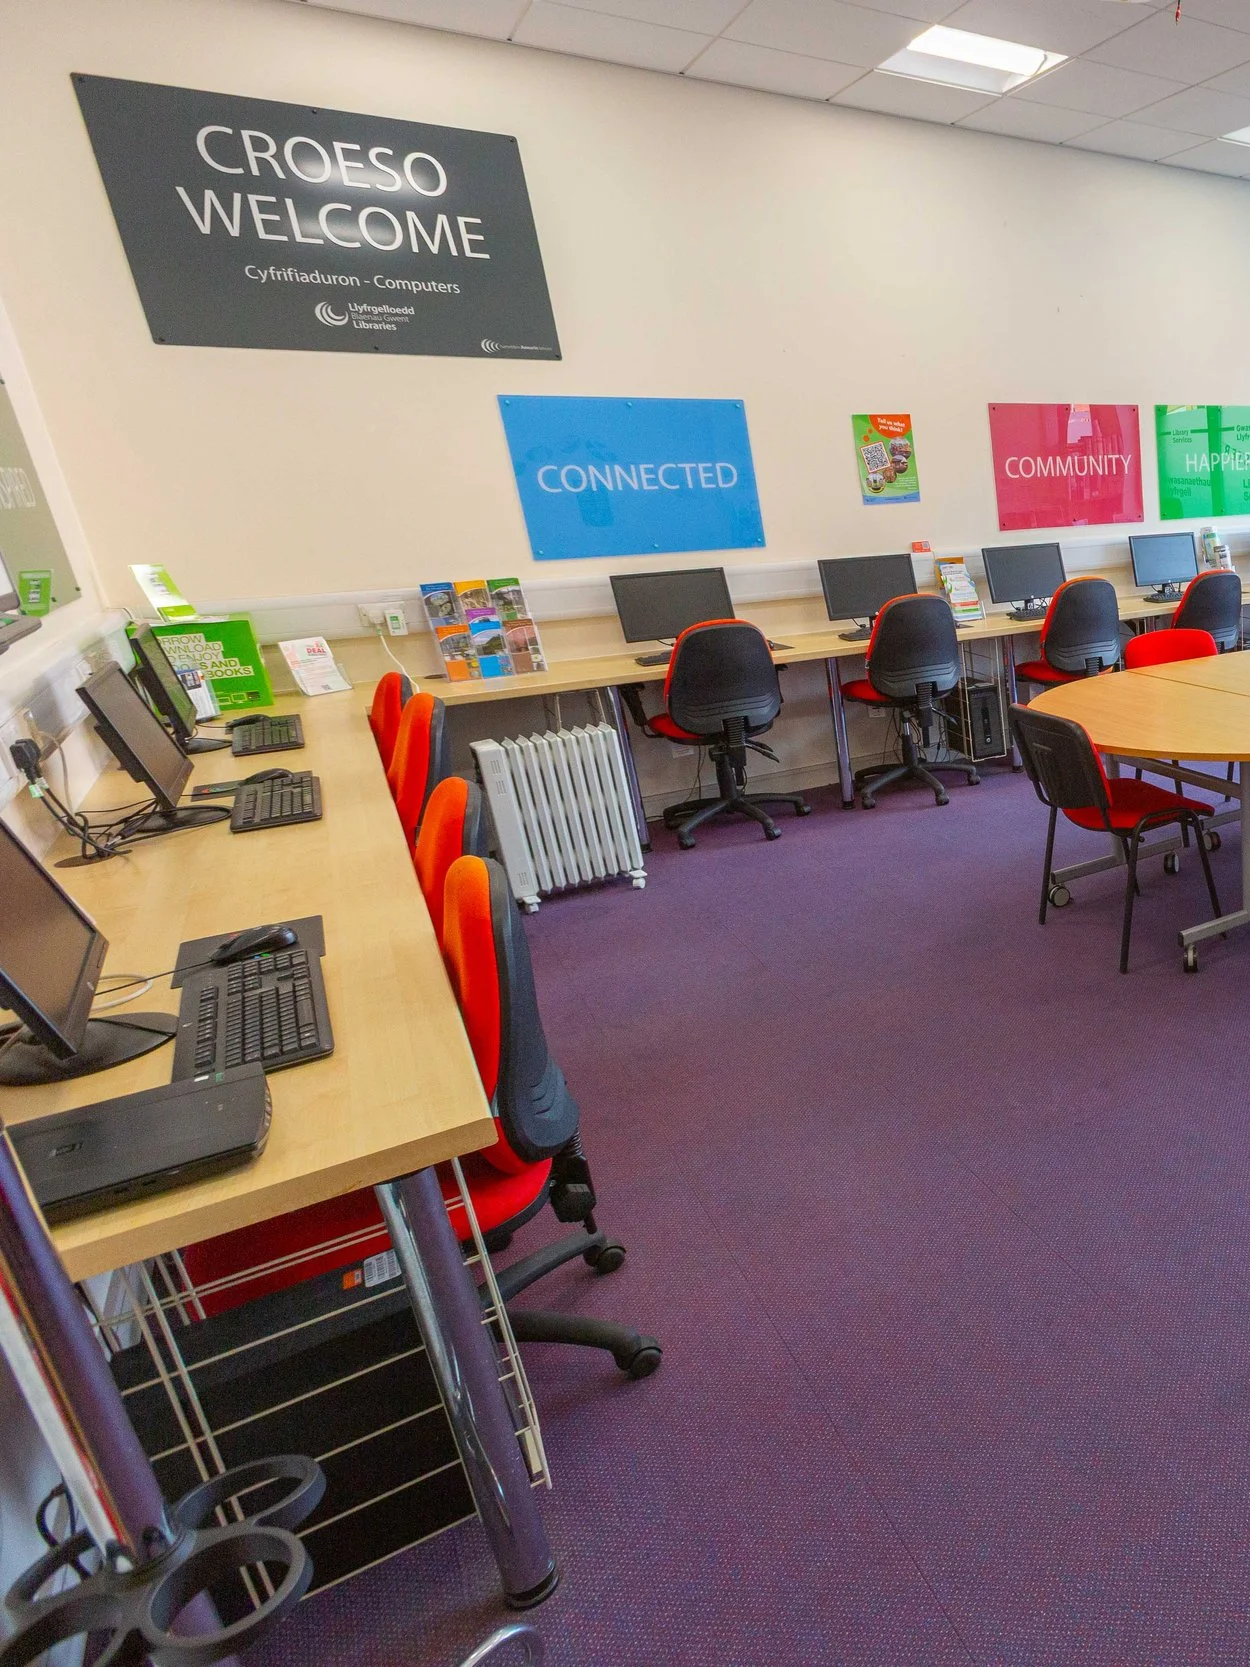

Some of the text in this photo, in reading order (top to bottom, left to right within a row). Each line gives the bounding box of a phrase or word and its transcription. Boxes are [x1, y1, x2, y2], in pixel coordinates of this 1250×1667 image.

[196, 125, 448, 197] CROESO
[175, 186, 491, 260] WELCOME
[244, 265, 361, 287] Cyfrifiaduron
[373, 275, 461, 294] Computers
[348, 302, 415, 315] Llyfrgelloedd
[351, 312, 409, 323] Blaenau Gwent
[353, 320, 397, 331] Libraries
[1005, 454, 1132, 479] COMMUNITY
[537, 462, 738, 493] CONNECTED
[1168, 477, 1211, 487] wasanaethau
[165, 642, 221, 655] WNLOAD
[210, 659, 238, 669] AND
[206, 667, 252, 679] BOOKS
